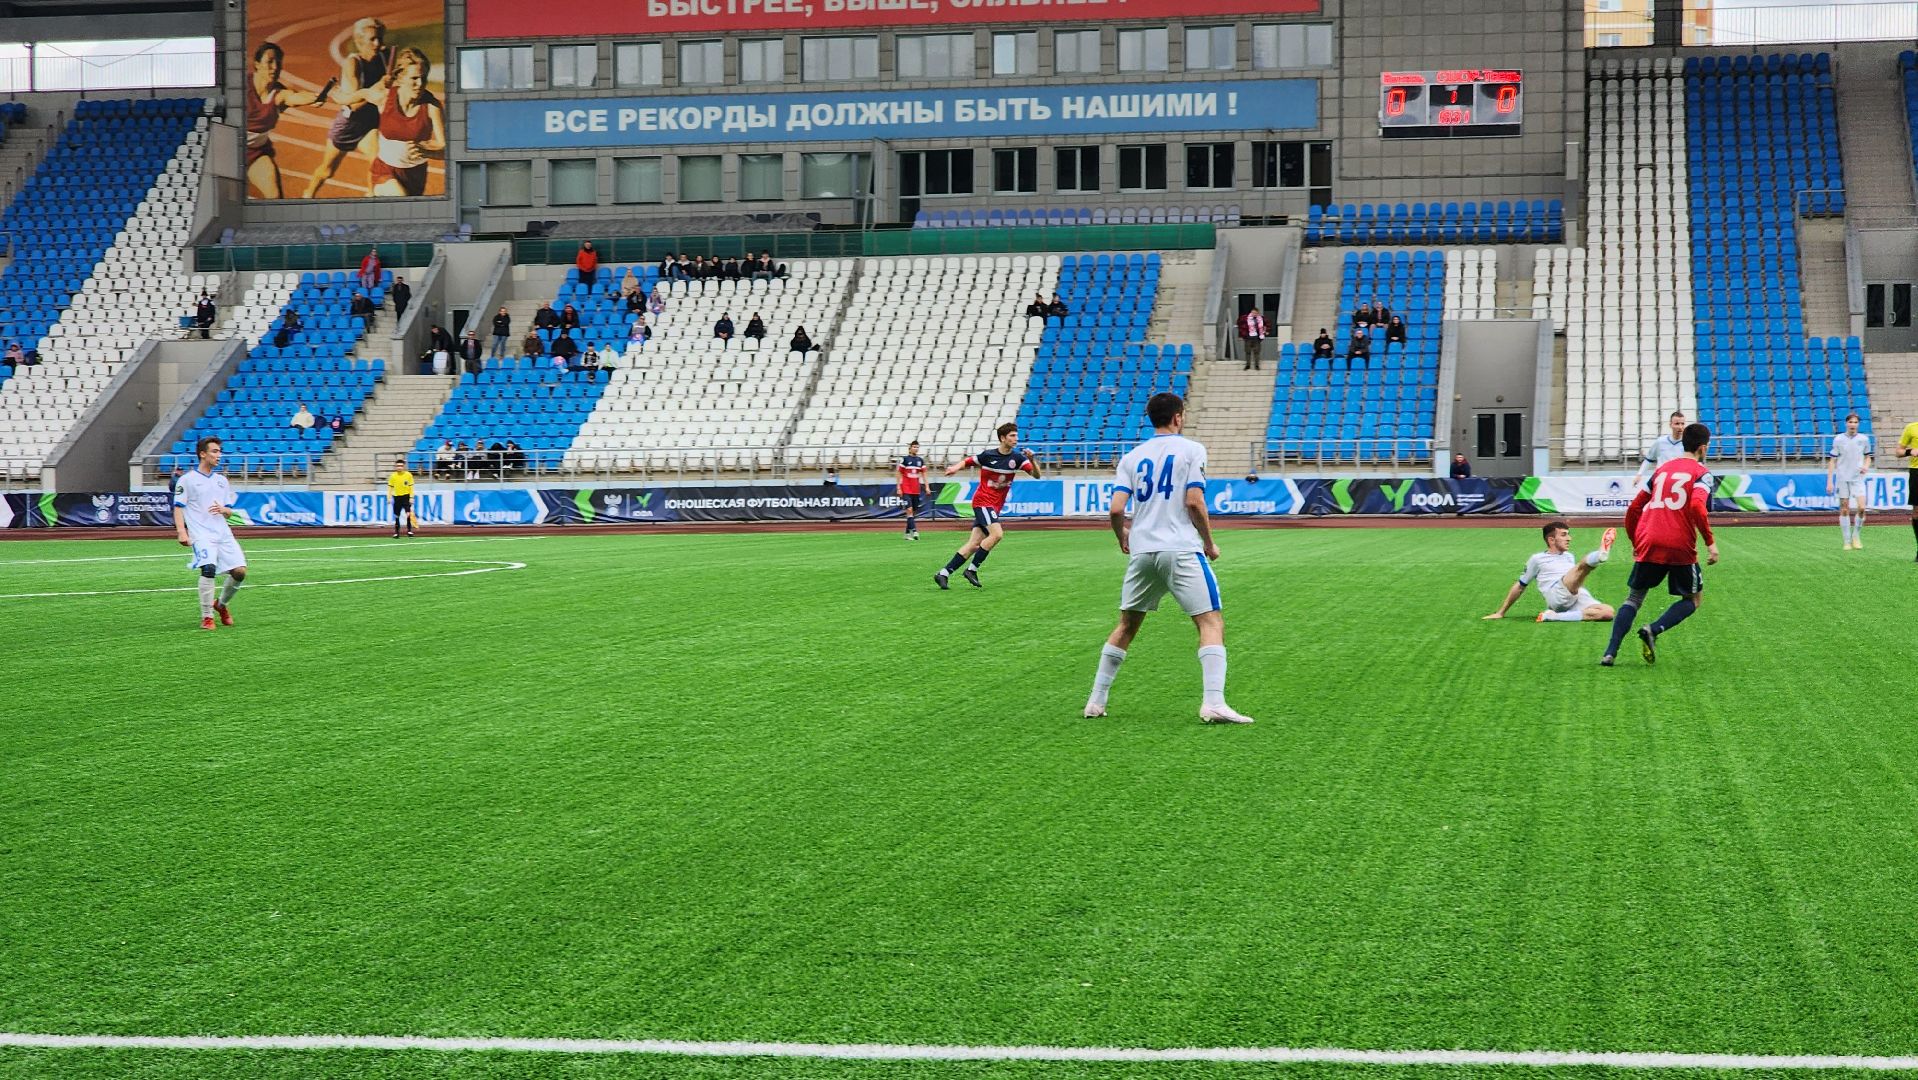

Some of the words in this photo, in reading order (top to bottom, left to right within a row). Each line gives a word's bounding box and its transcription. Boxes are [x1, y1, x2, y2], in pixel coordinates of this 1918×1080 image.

[545, 109, 608, 133] ВСЕ
[618, 105, 776, 133] РЕКОРДЫ
[785, 100, 944, 132] ДОЛЖНЫ
[954, 97, 1052, 123] БЫТЬ
[1062, 92, 1217, 119] НАШИМИ
[1137, 454, 1176, 503] 34
[1651, 471, 1692, 511] 13
[335, 494, 442, 522] ГАЗПМ
[664, 498, 746, 509] ЮНОШЕСКАЯ
[746, 497, 830, 508] ФУТБОЛЬНАЯ
[831, 496, 864, 507] ЛИГА
[1411, 492, 1455, 507] ЮФЛ
[1586, 497, 1632, 507] Наслед
